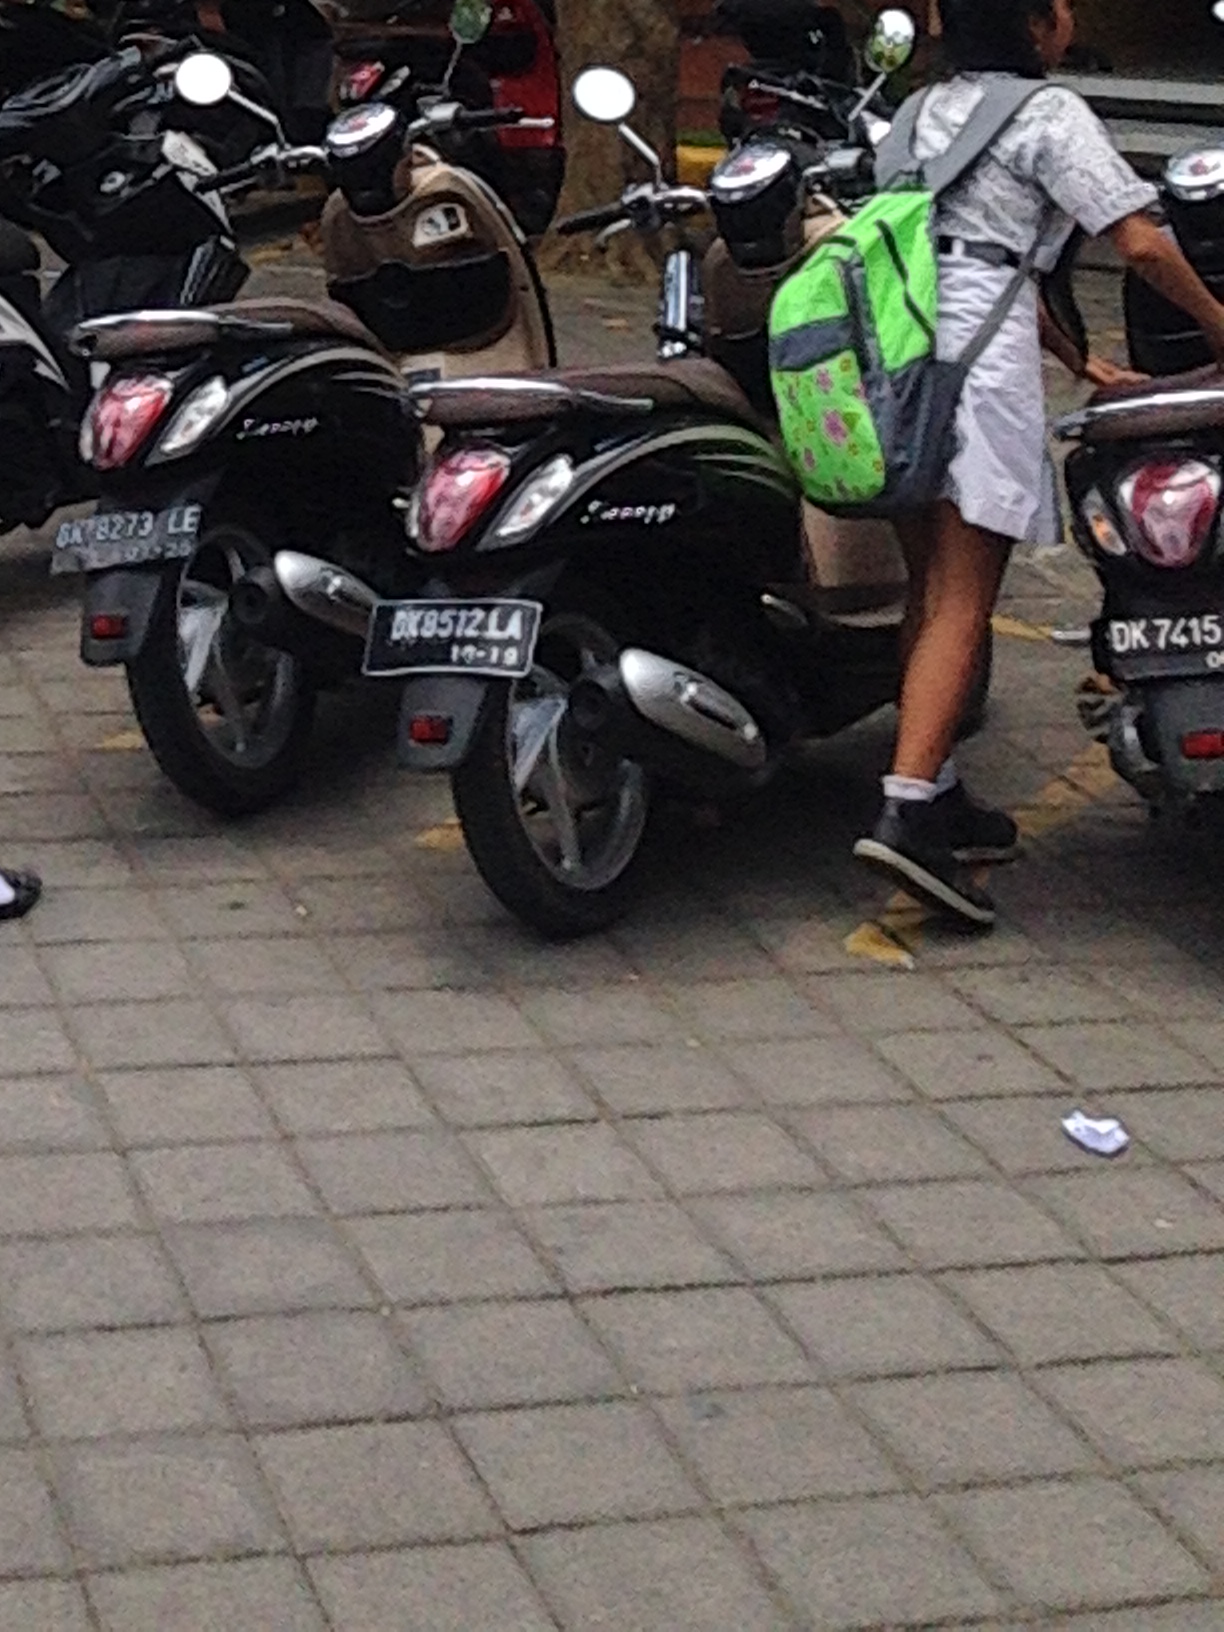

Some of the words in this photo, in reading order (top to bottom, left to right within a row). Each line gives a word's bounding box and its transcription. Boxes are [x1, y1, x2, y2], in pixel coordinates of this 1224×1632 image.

[166, 505, 203, 534] LE
[1110, 619, 1150, 653] DK
[1152, 615, 1222, 650] 7415
